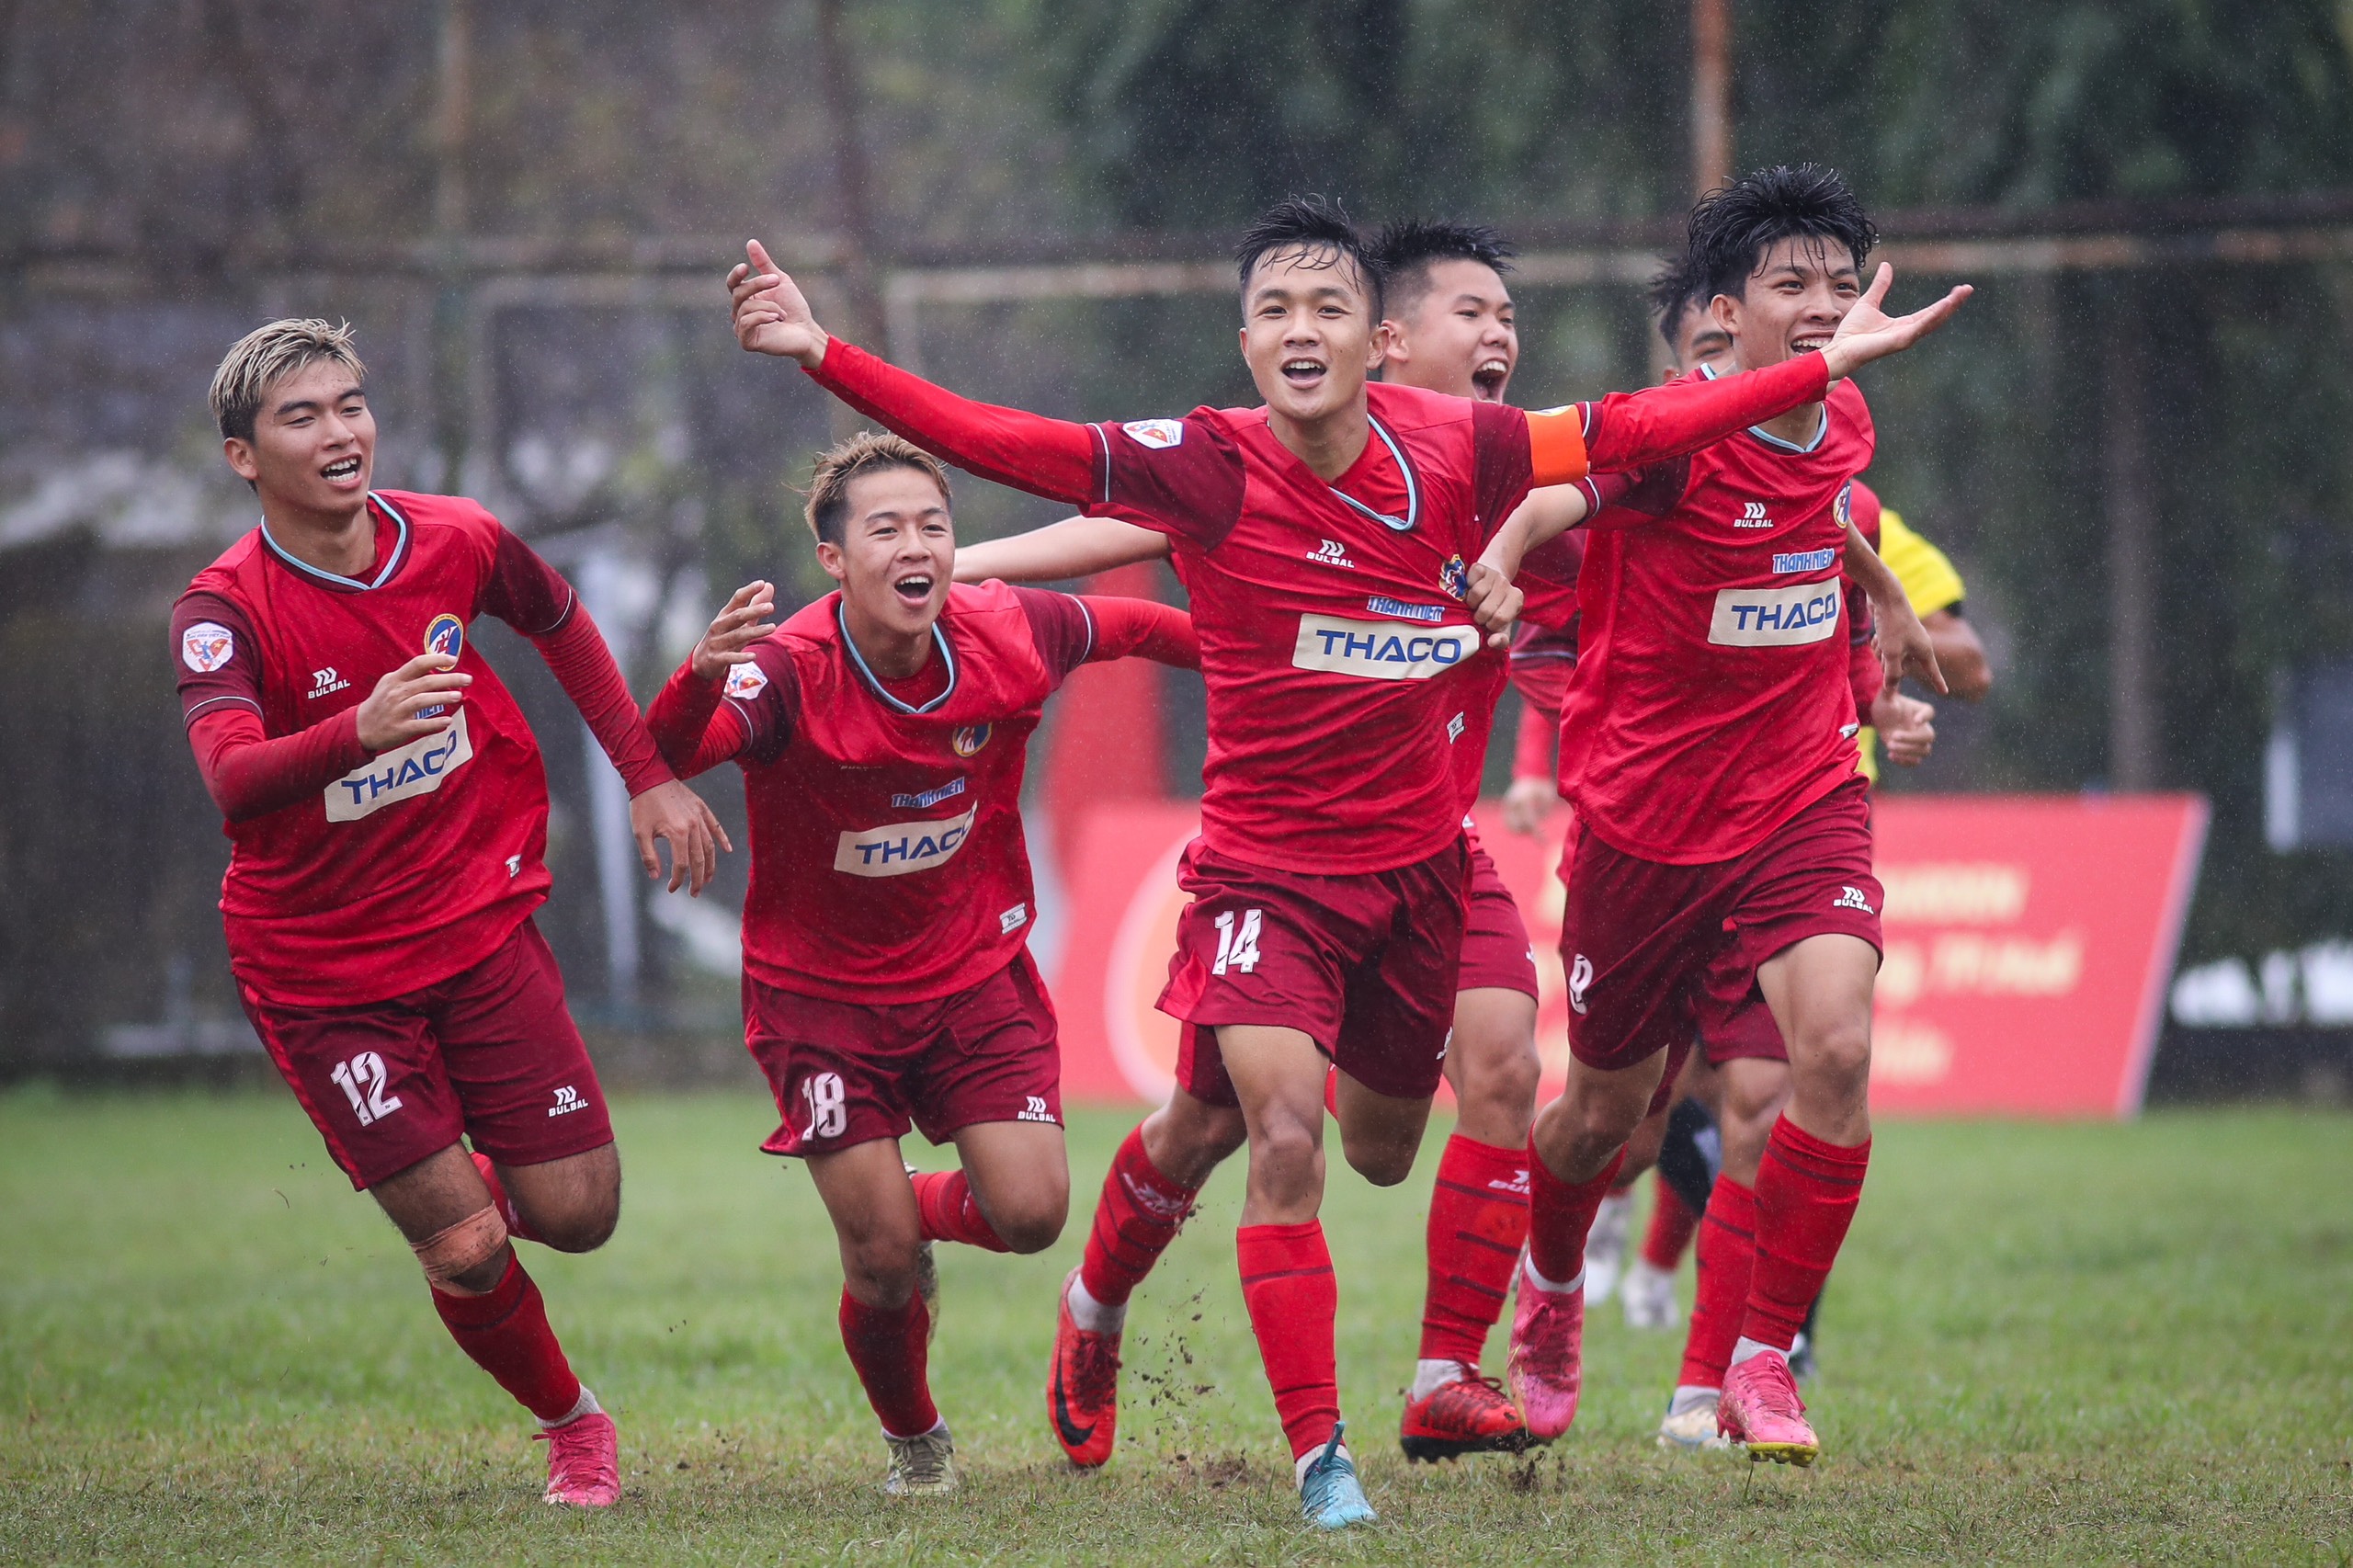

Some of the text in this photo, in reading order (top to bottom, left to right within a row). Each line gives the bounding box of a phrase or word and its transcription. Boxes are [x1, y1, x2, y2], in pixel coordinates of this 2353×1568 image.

[1733, 519, 1774, 528] BULBAL
[1306, 551, 1355, 568] BULBAL
[1732, 592, 1836, 631] THACO
[1316, 630, 1461, 665] THACO
[307, 678, 350, 699] BULBAL
[341, 730, 457, 804] THACO
[1833, 899, 1874, 915] BULBAL
[1211, 909, 1262, 976] 14
[330, 1051, 404, 1127] 12
[548, 1098, 589, 1117] BULBAL
[801, 1073, 847, 1142] 18
